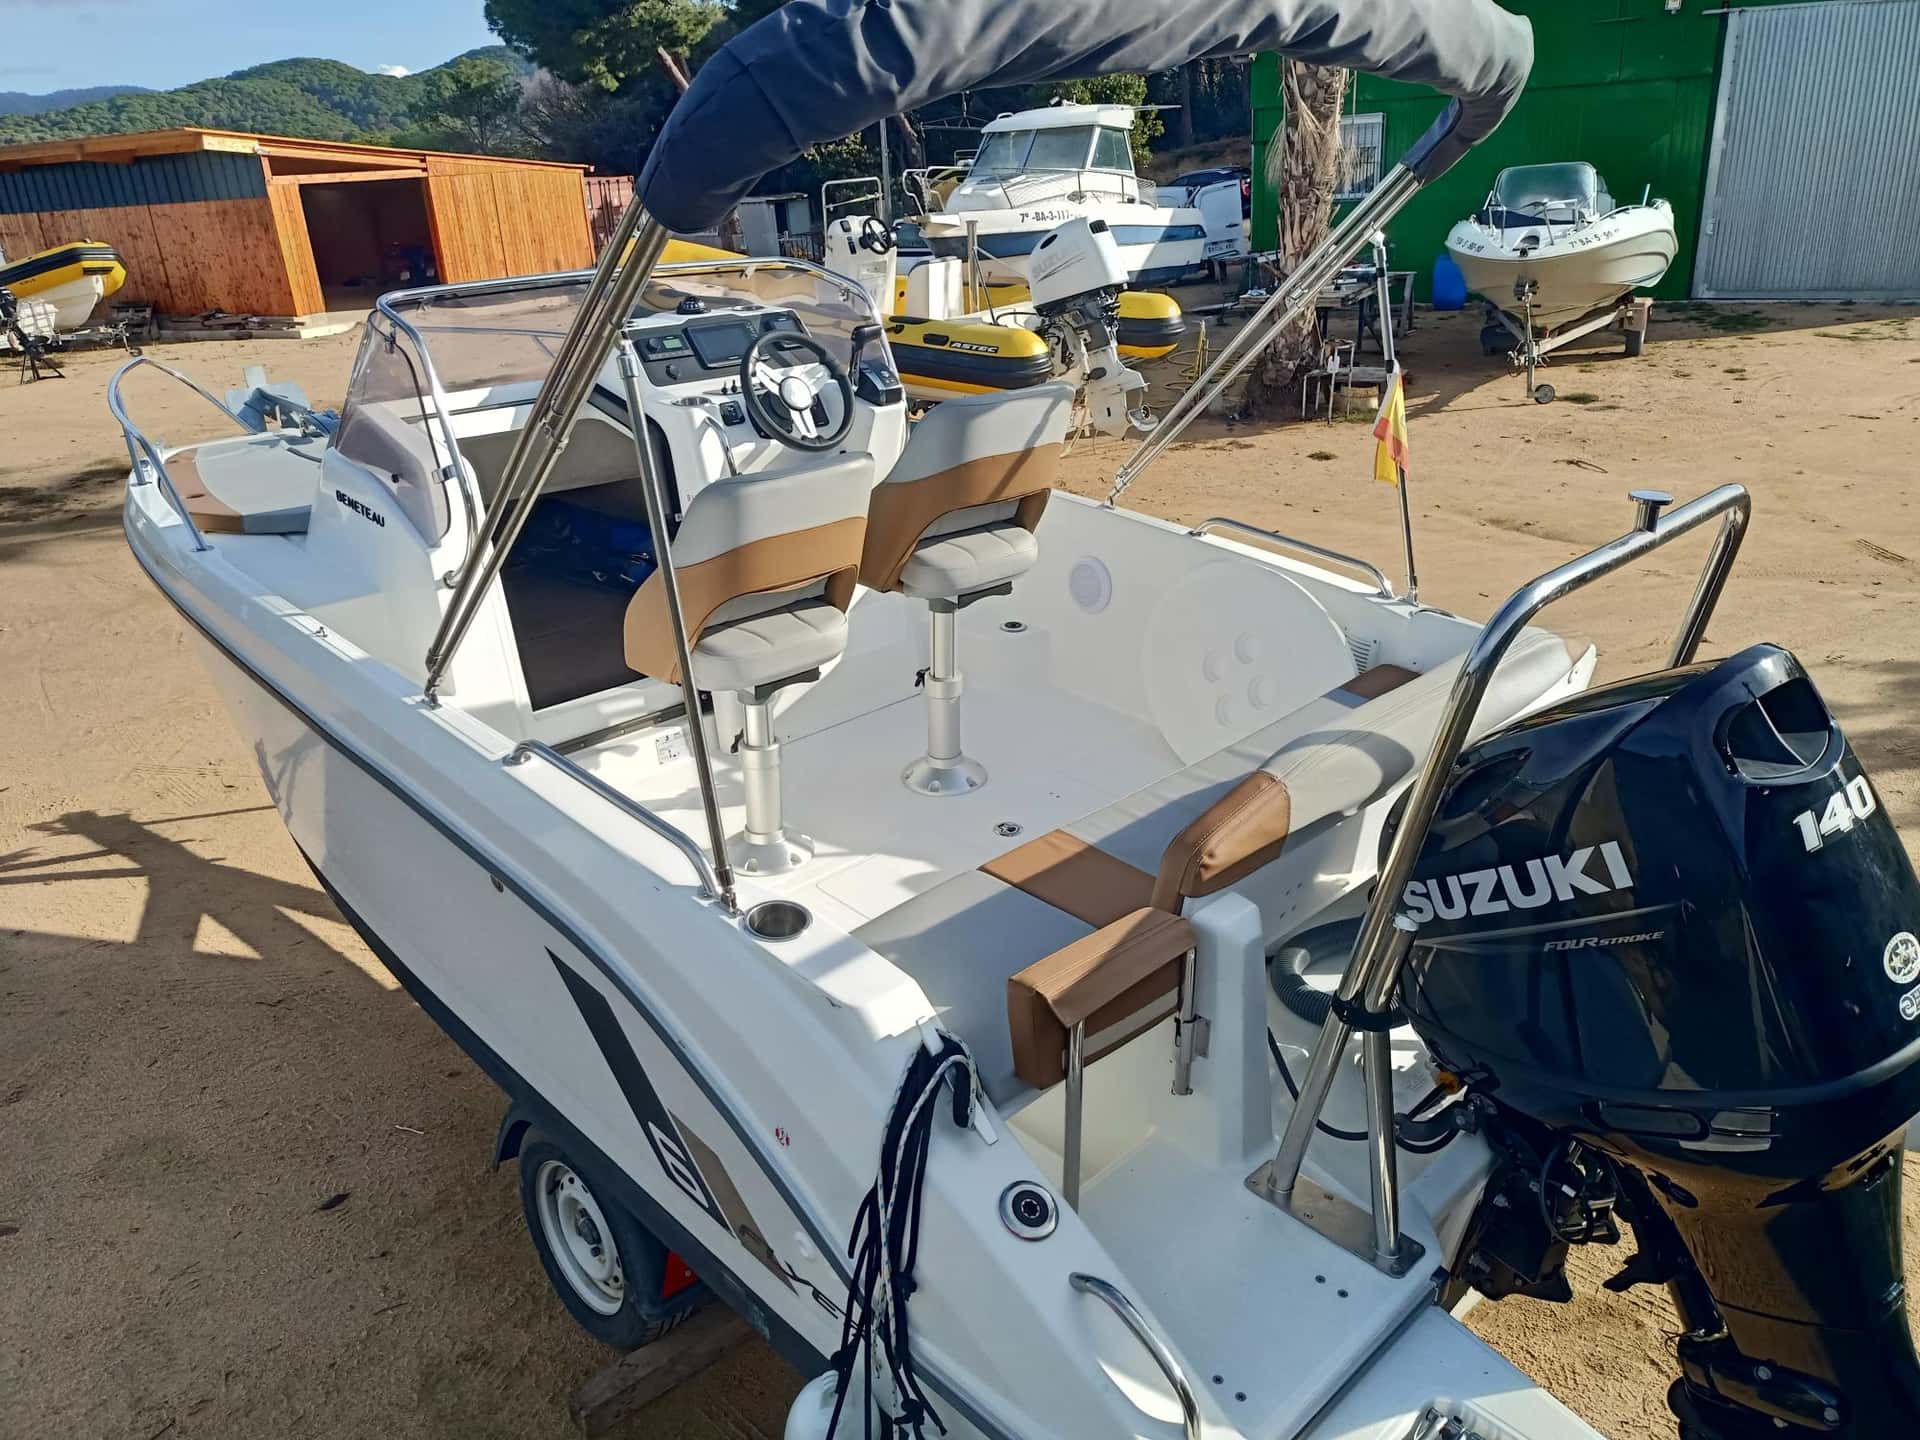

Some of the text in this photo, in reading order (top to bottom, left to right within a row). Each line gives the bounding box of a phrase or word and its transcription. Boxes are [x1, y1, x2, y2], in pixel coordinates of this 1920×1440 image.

[951, 342, 998, 353] ASTEC
[336, 489, 385, 527] BENETEAU
[1792, 774, 1877, 853] 140
[1402, 840, 1634, 923] SUZUKI
